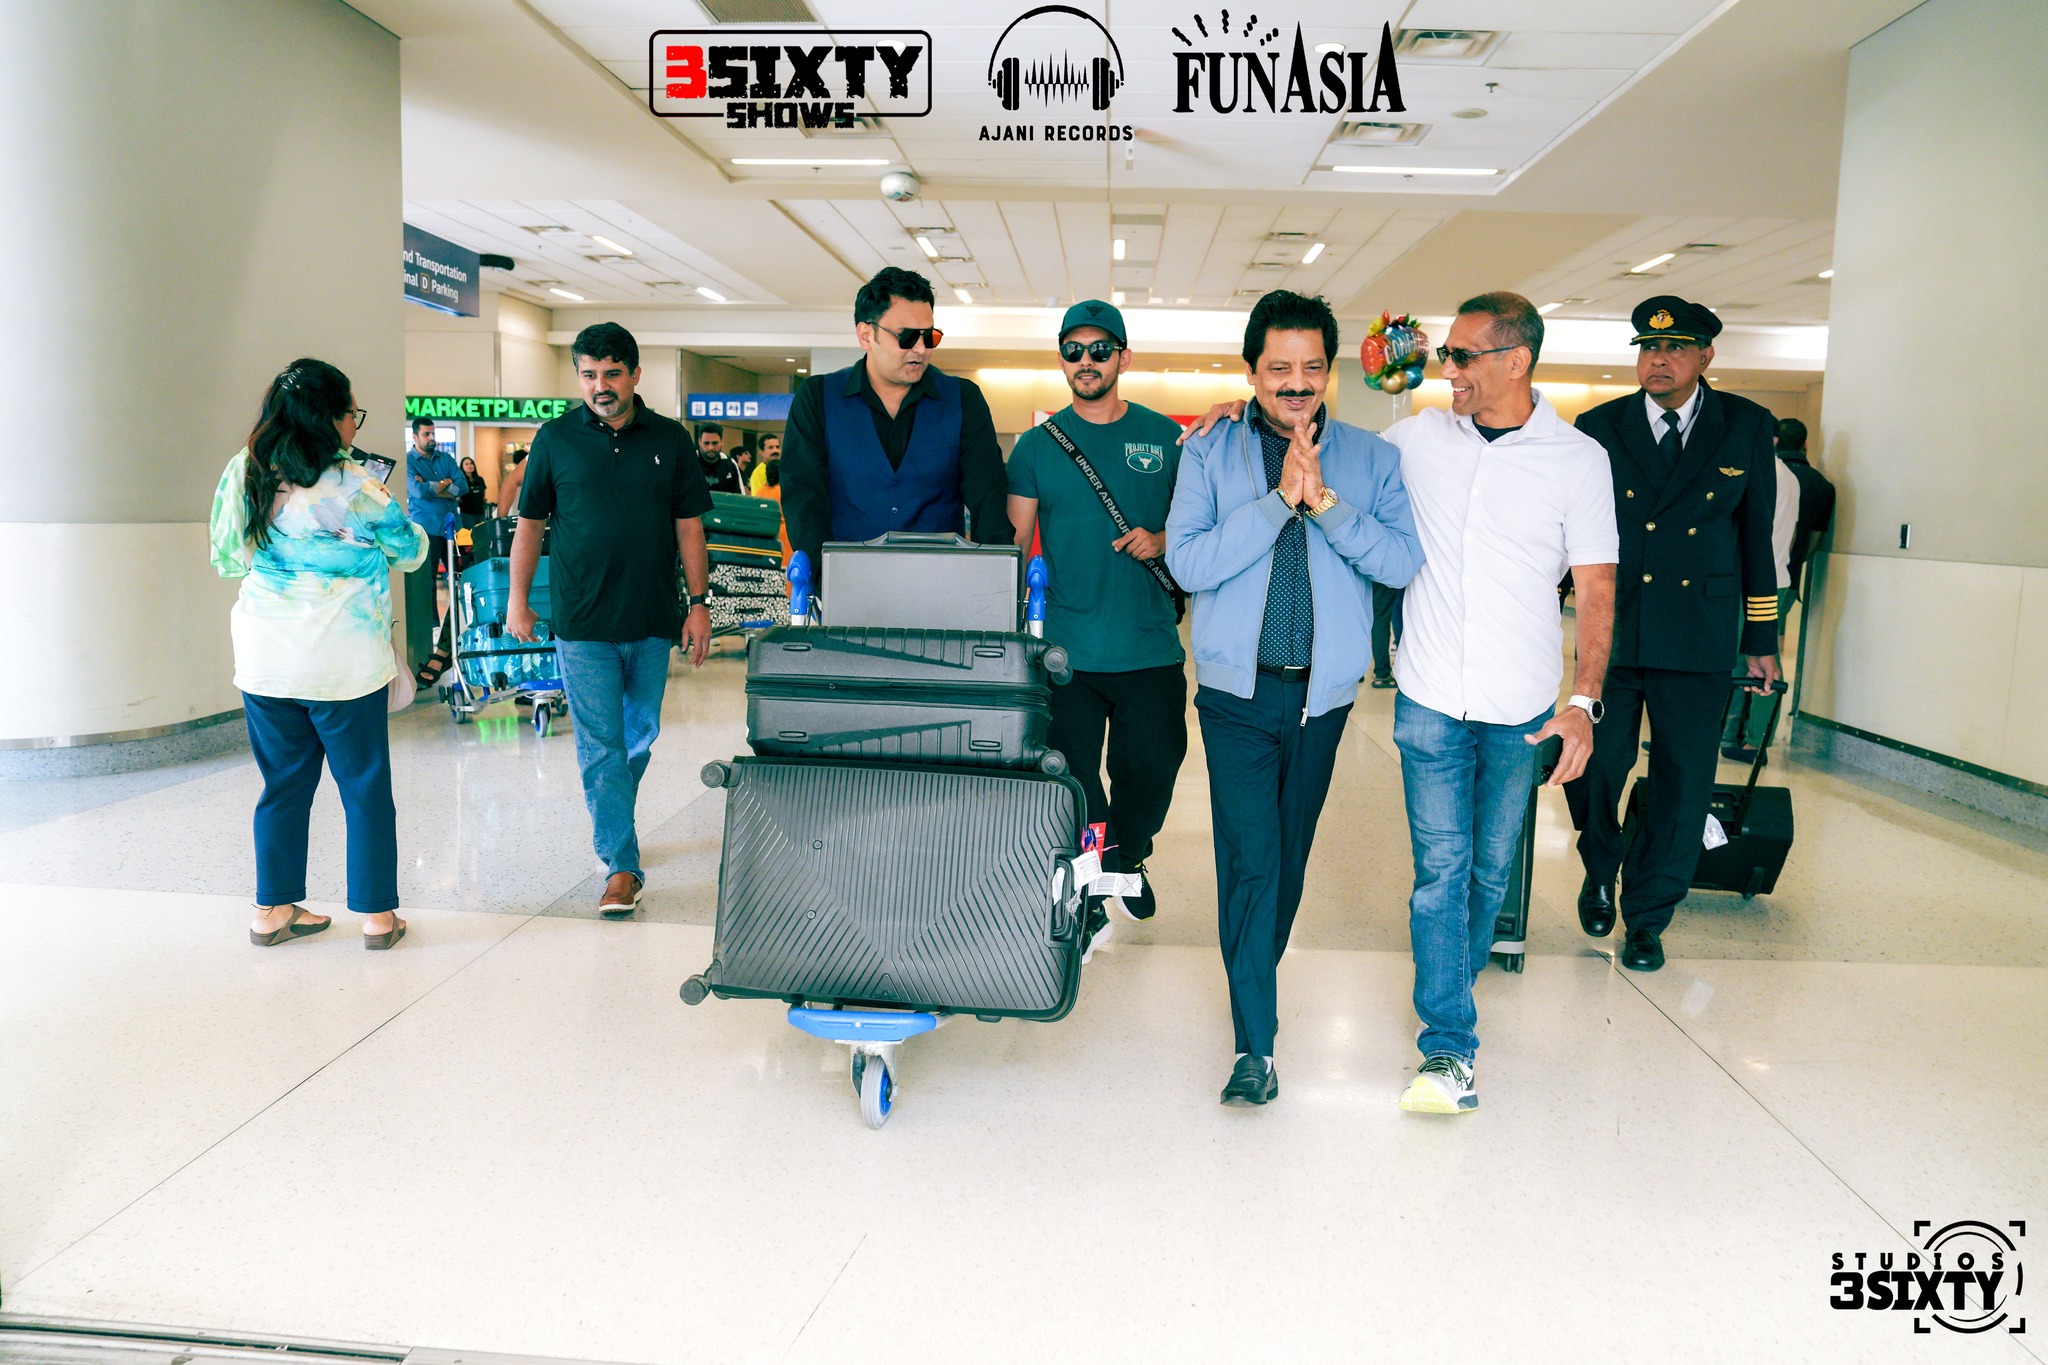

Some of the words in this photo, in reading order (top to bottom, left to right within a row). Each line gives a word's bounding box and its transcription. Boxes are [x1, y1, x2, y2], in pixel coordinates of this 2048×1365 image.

[404, 250, 414, 264] nd
[415, 251, 467, 283] Transportation
[422, 276, 428, 290] D
[431, 279, 459, 303] Parking
[405, 398, 567, 419] MARKETPLACE
[1043, 421, 1075, 453] ARMOUR
[1075, 454, 1103, 491] UNDER
